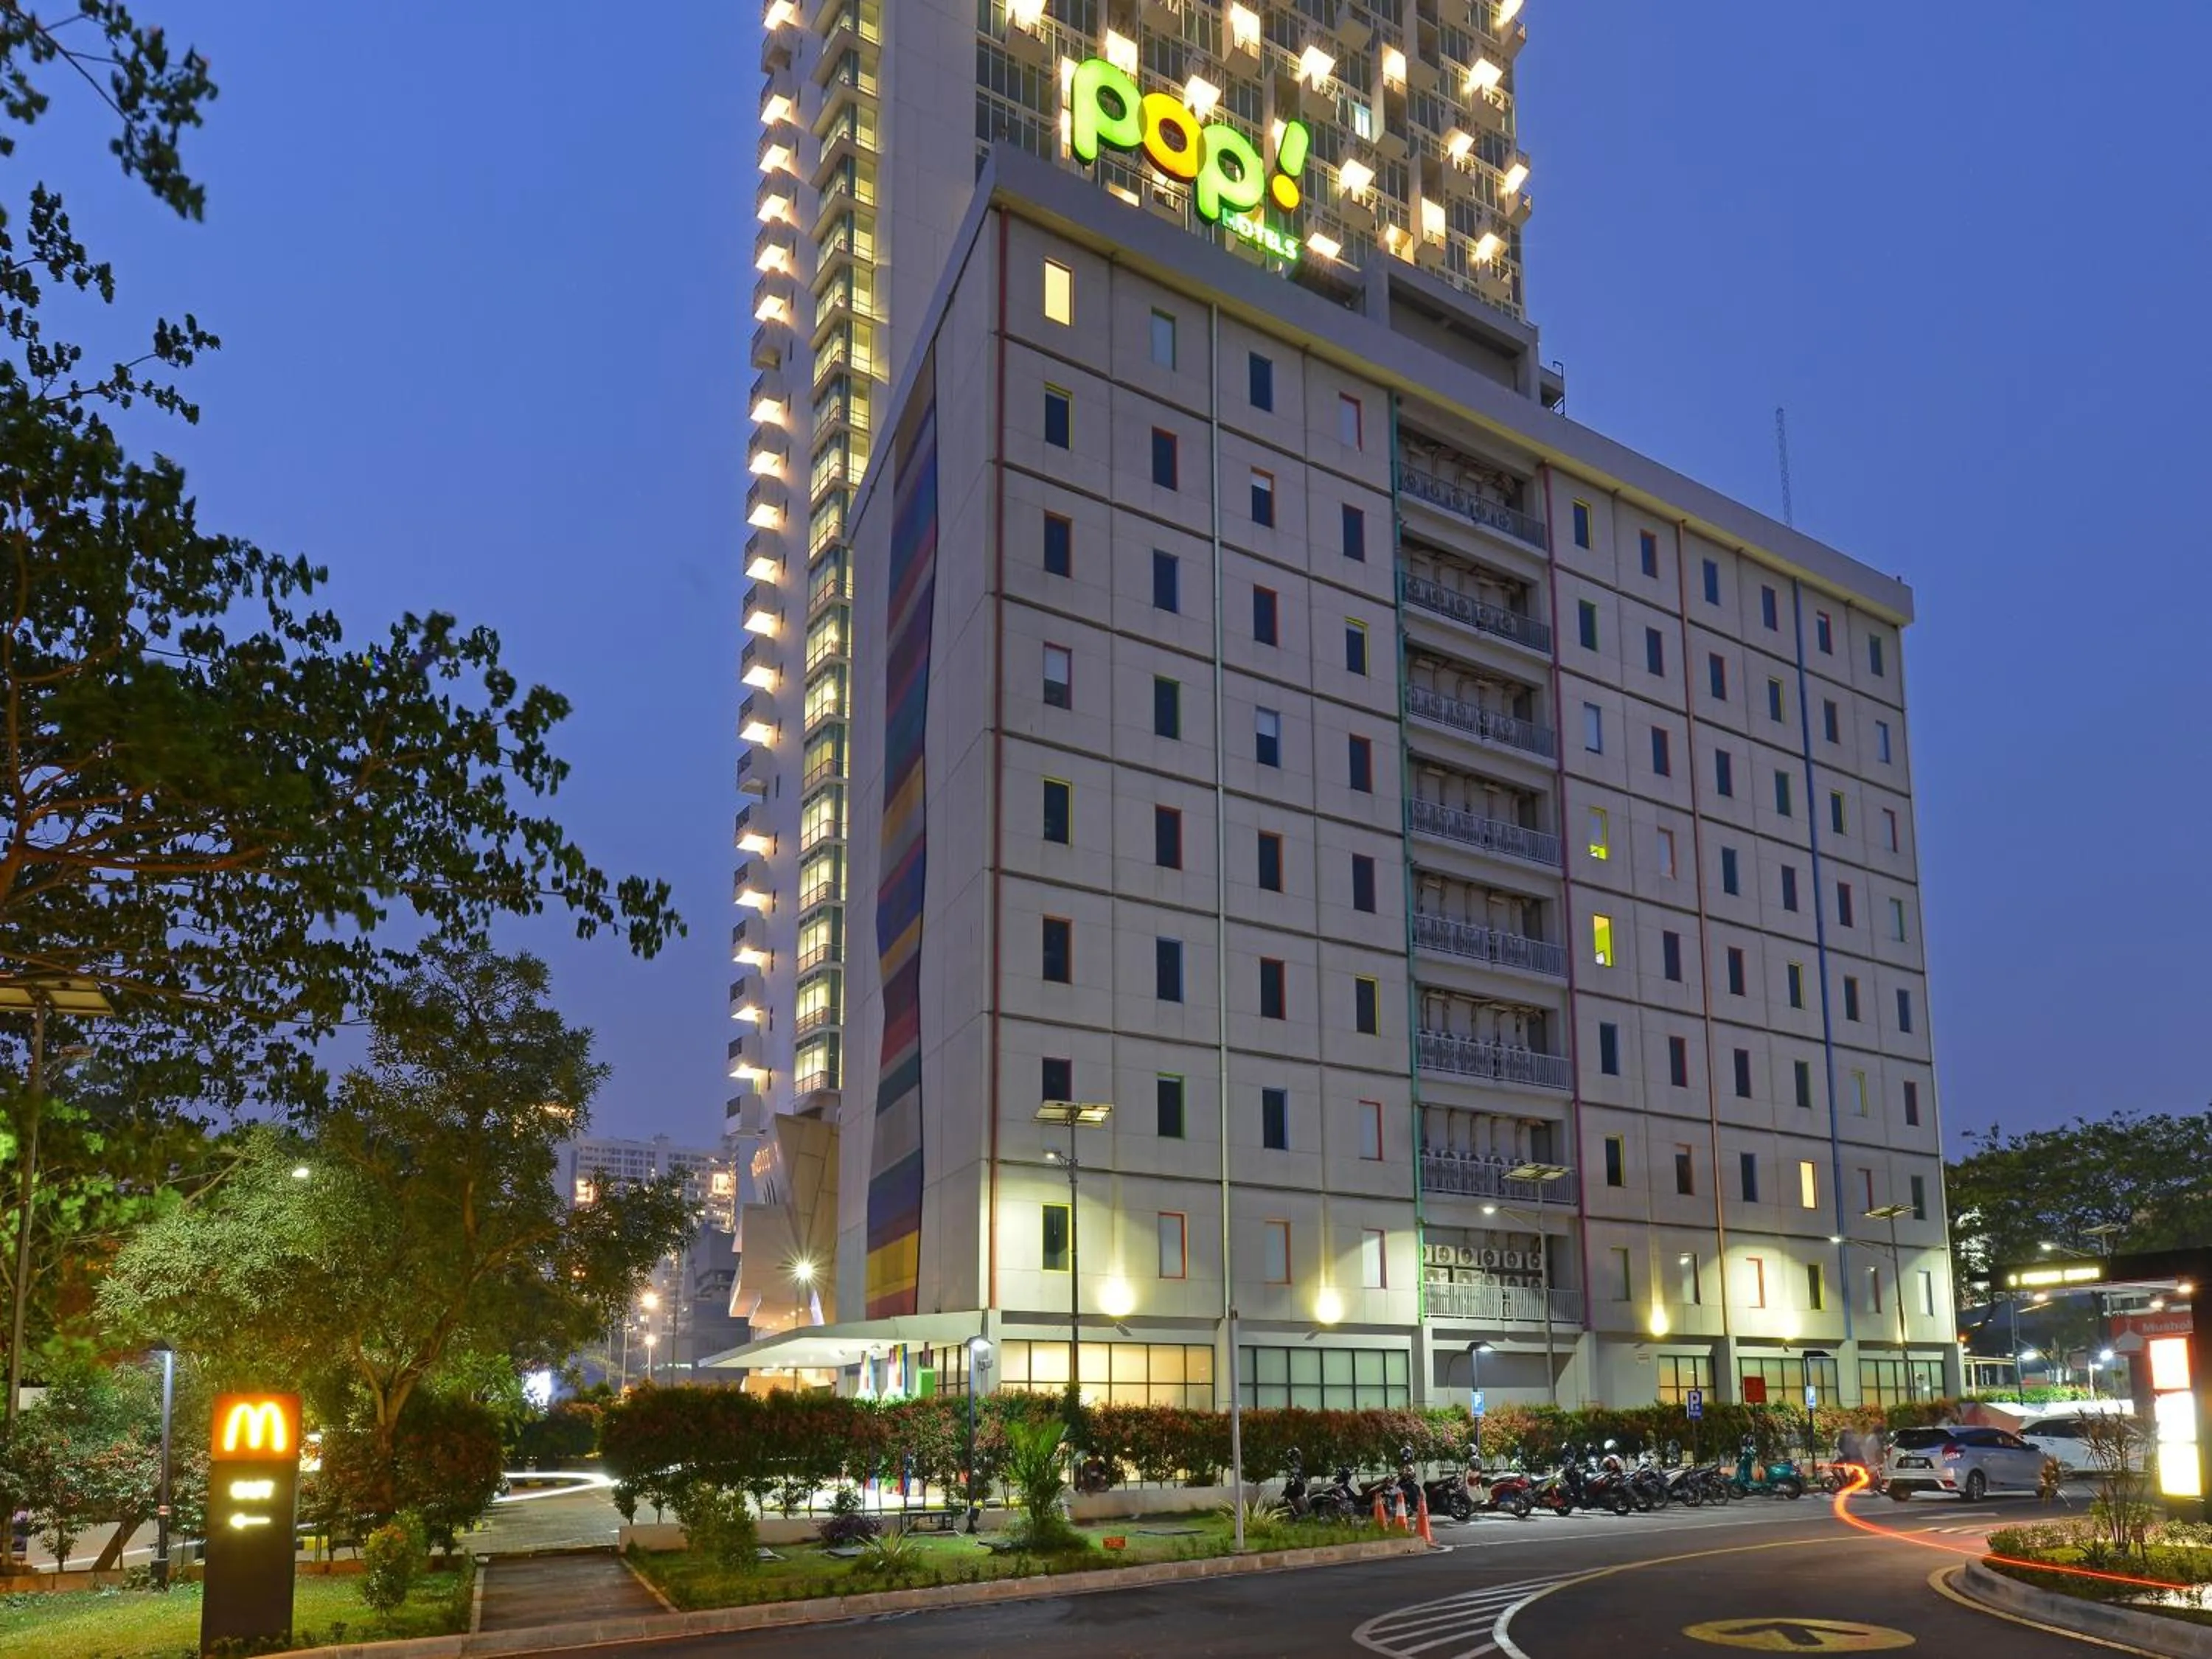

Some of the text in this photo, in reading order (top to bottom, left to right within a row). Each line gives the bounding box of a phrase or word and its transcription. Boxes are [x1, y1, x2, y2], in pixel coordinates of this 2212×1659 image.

[1222, 207, 1297, 260] HOTELS
[1475, 1394, 1481, 1408] P
[1690, 1391, 1700, 1411] P
